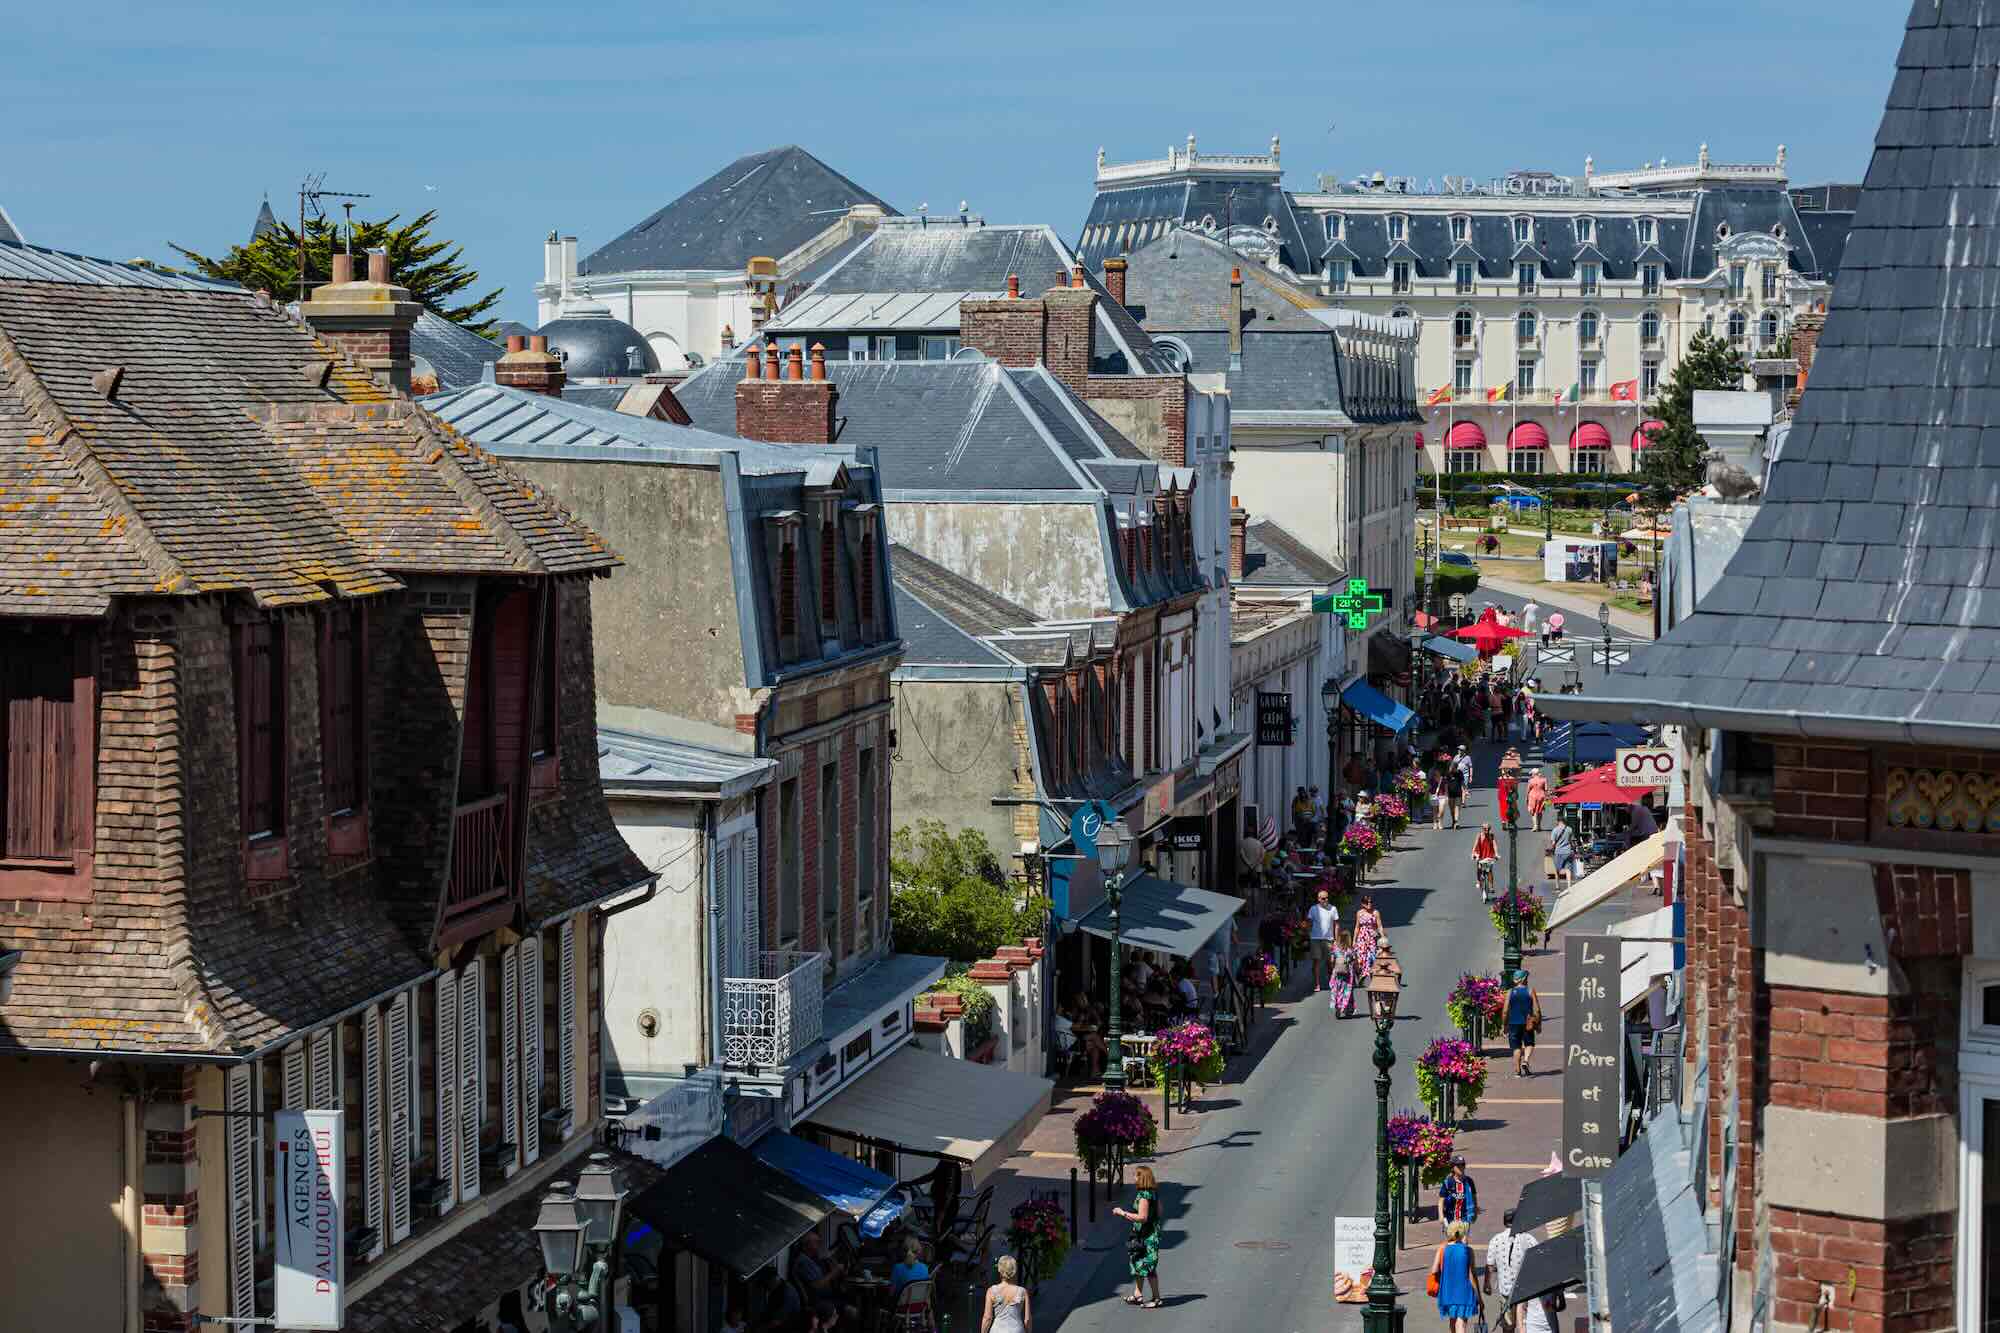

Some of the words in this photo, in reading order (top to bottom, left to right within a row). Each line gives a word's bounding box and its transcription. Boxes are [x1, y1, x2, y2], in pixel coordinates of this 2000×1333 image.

[1582, 942, 1605, 964] Le
[1579, 977, 1606, 1002] fils
[1582, 1012, 1603, 1033] du
[1567, 1044, 1616, 1066] Pôvre
[1582, 1086, 1602, 1101] et
[1582, 1121, 1600, 1134] sa
[1569, 1147, 1613, 1168] Cave
[294, 1128, 310, 1228] AGENCES
[316, 1130, 331, 1294] D'AUJOURD'HUI
